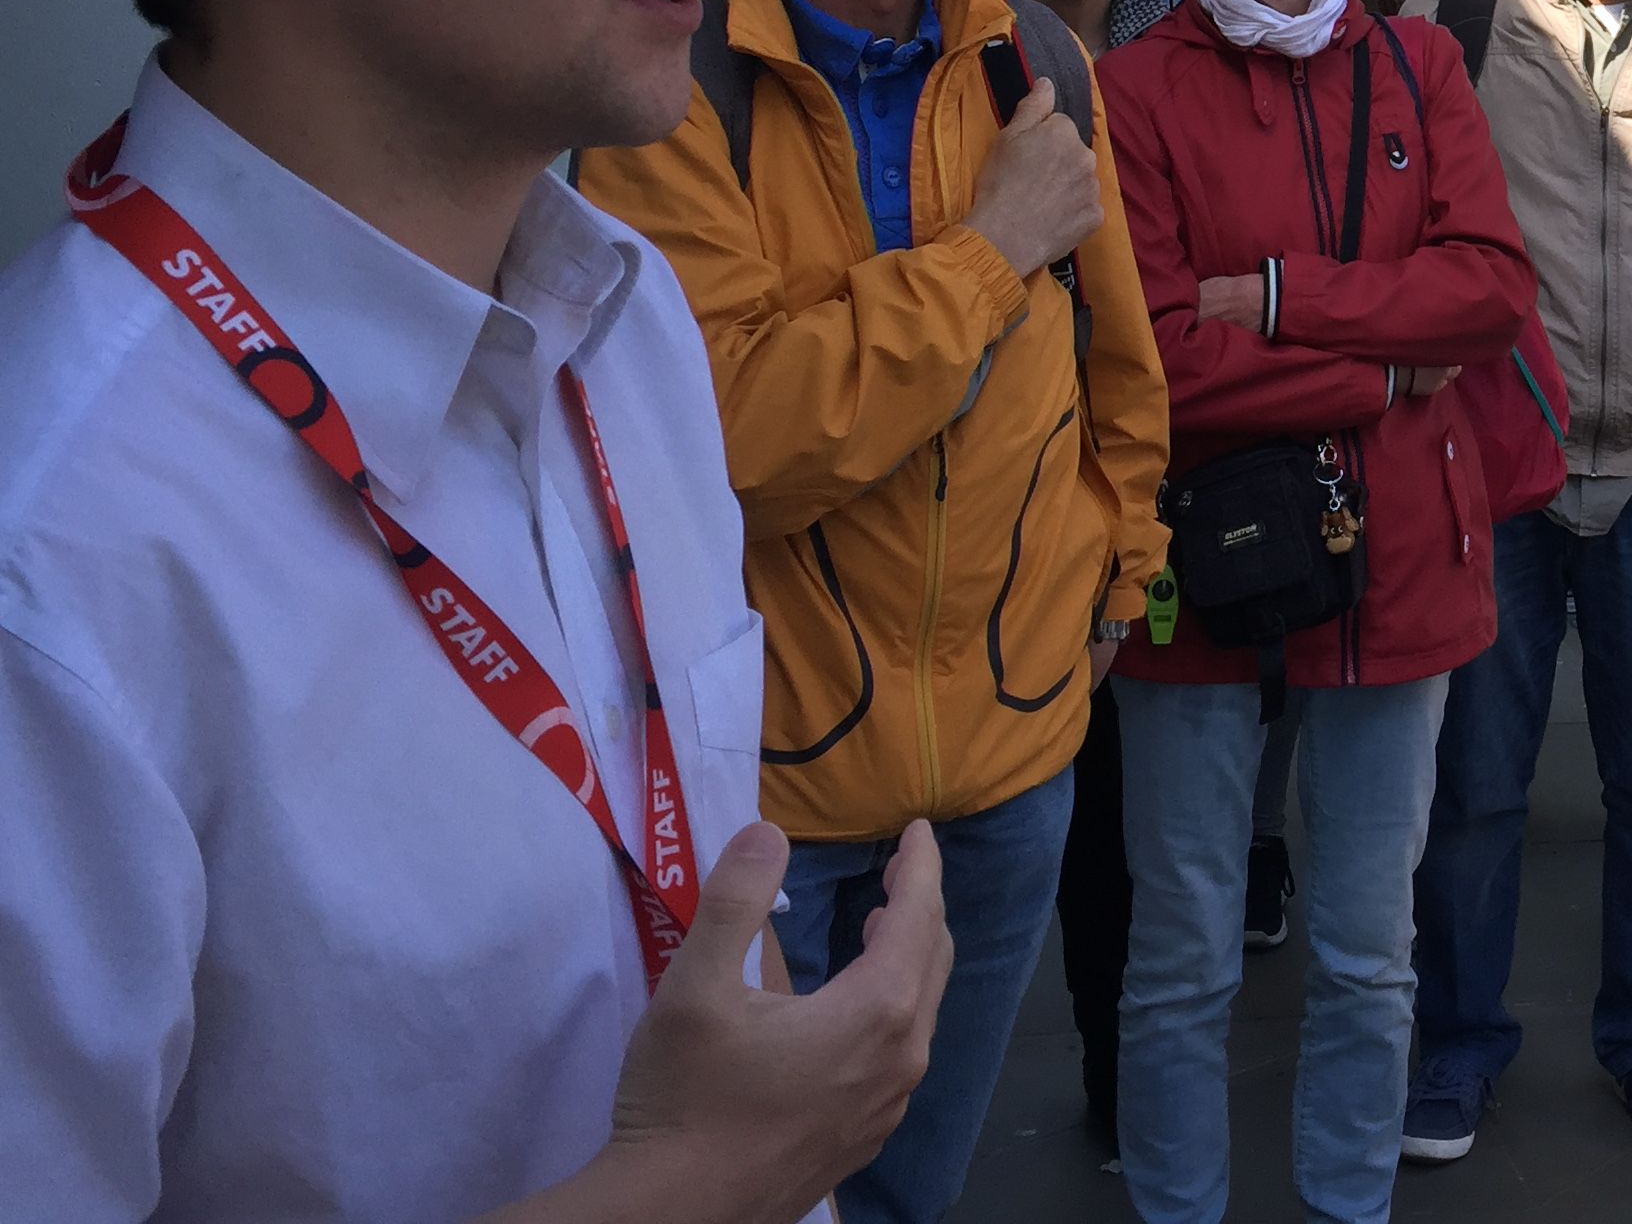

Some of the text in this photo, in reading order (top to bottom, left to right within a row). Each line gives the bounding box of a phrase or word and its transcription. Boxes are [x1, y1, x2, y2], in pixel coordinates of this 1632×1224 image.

[162, 249, 277, 352] STAFF
[420, 588, 520, 683] STAFF
[652, 768, 685, 890] STAFF
